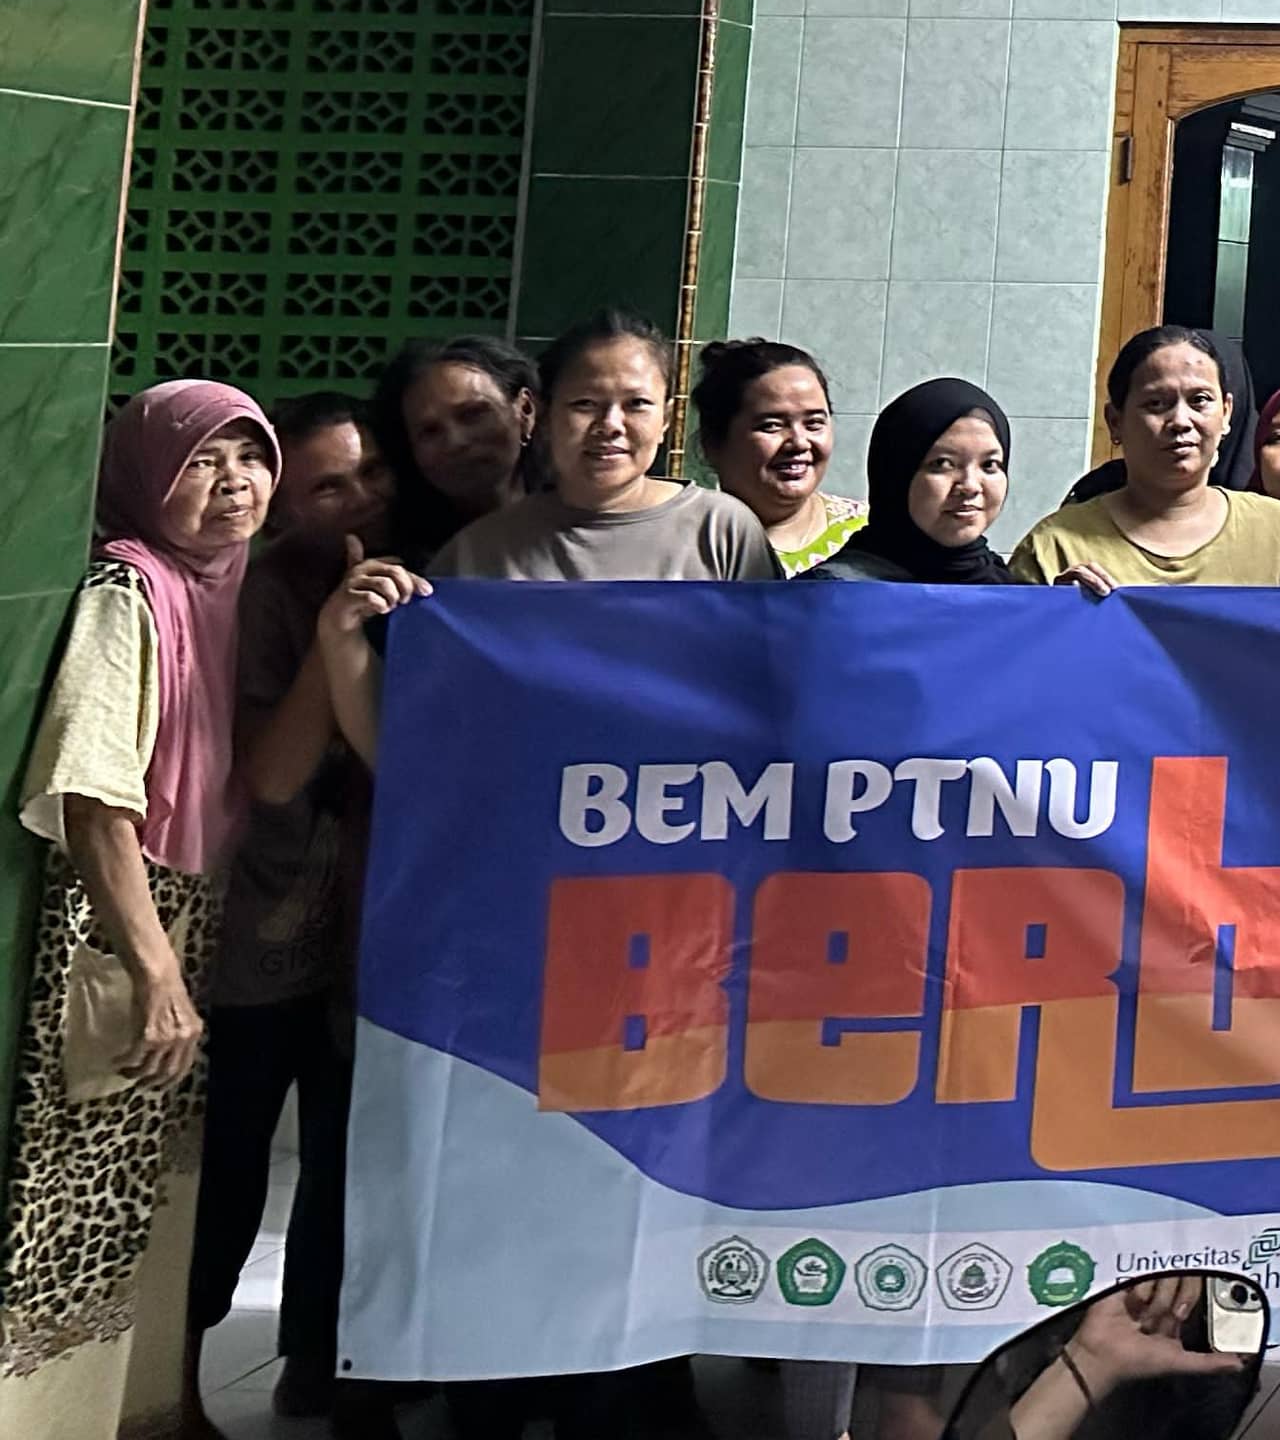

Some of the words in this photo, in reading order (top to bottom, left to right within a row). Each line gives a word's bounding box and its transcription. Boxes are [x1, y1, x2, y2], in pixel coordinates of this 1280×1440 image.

[557, 761, 795, 847] BEM
[822, 756, 1119, 843] PTNU
[1115, 1245, 1242, 1273] Universitas
